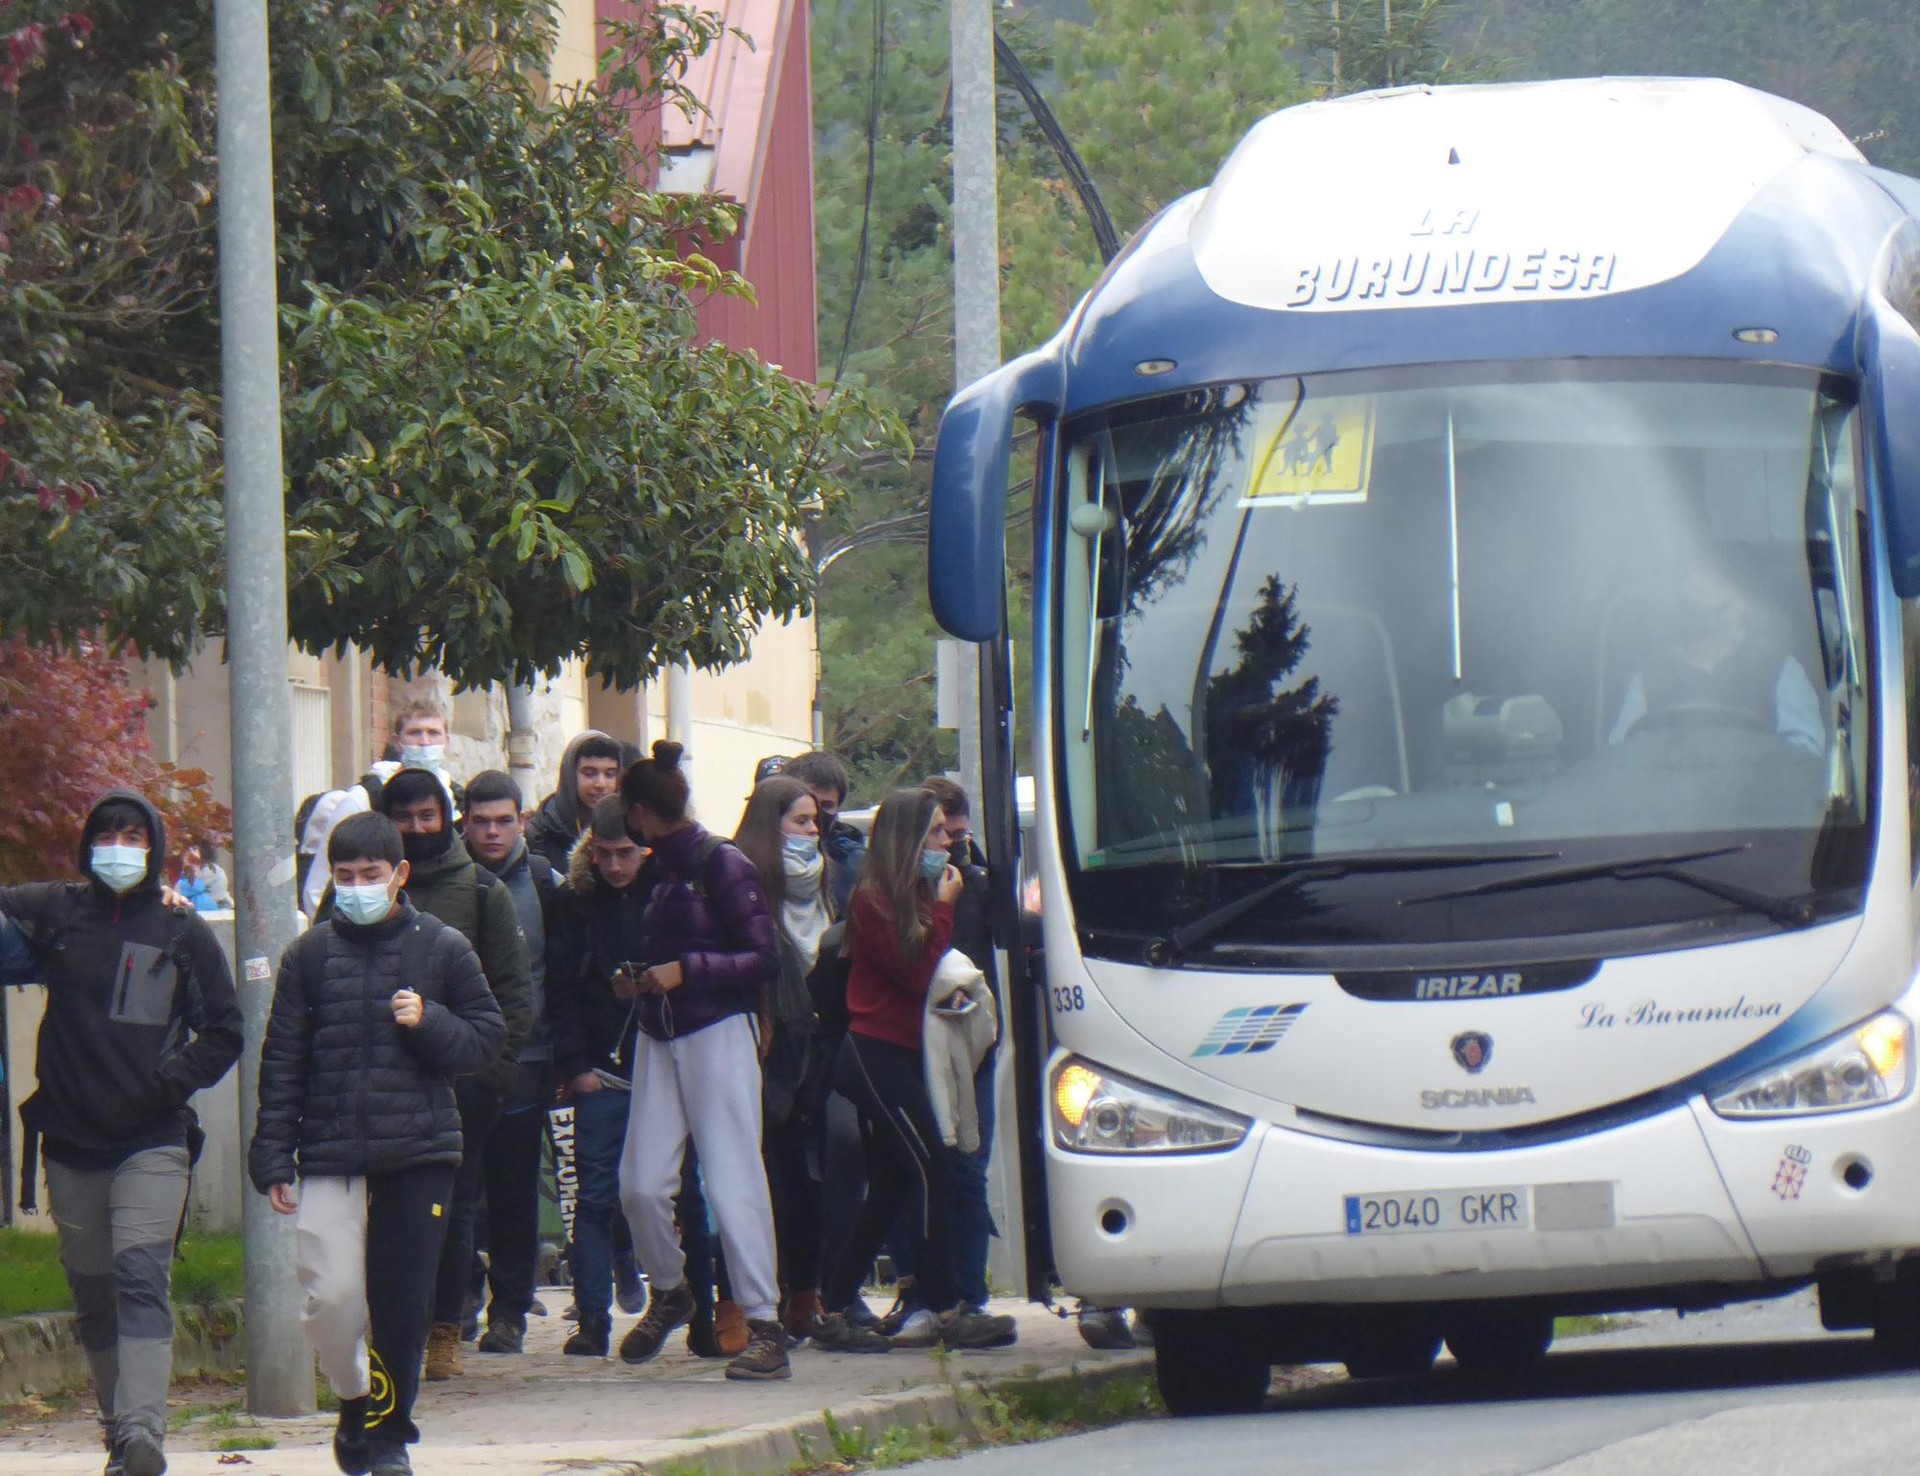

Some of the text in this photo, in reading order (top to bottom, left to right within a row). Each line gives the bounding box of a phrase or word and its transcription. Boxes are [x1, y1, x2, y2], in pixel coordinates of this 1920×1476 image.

[1409, 207, 1481, 237] LA
[1287, 248, 1616, 307] BURUNDESA
[1054, 985, 1084, 1012] 338
[1416, 972, 1522, 999] IRIZAR
[1578, 995, 1782, 1029] La Burundesa
[1421, 1086, 1536, 1109] SCANIA
[1364, 1196, 1440, 1230] 2040
[1460, 1192, 1518, 1224] GKR
